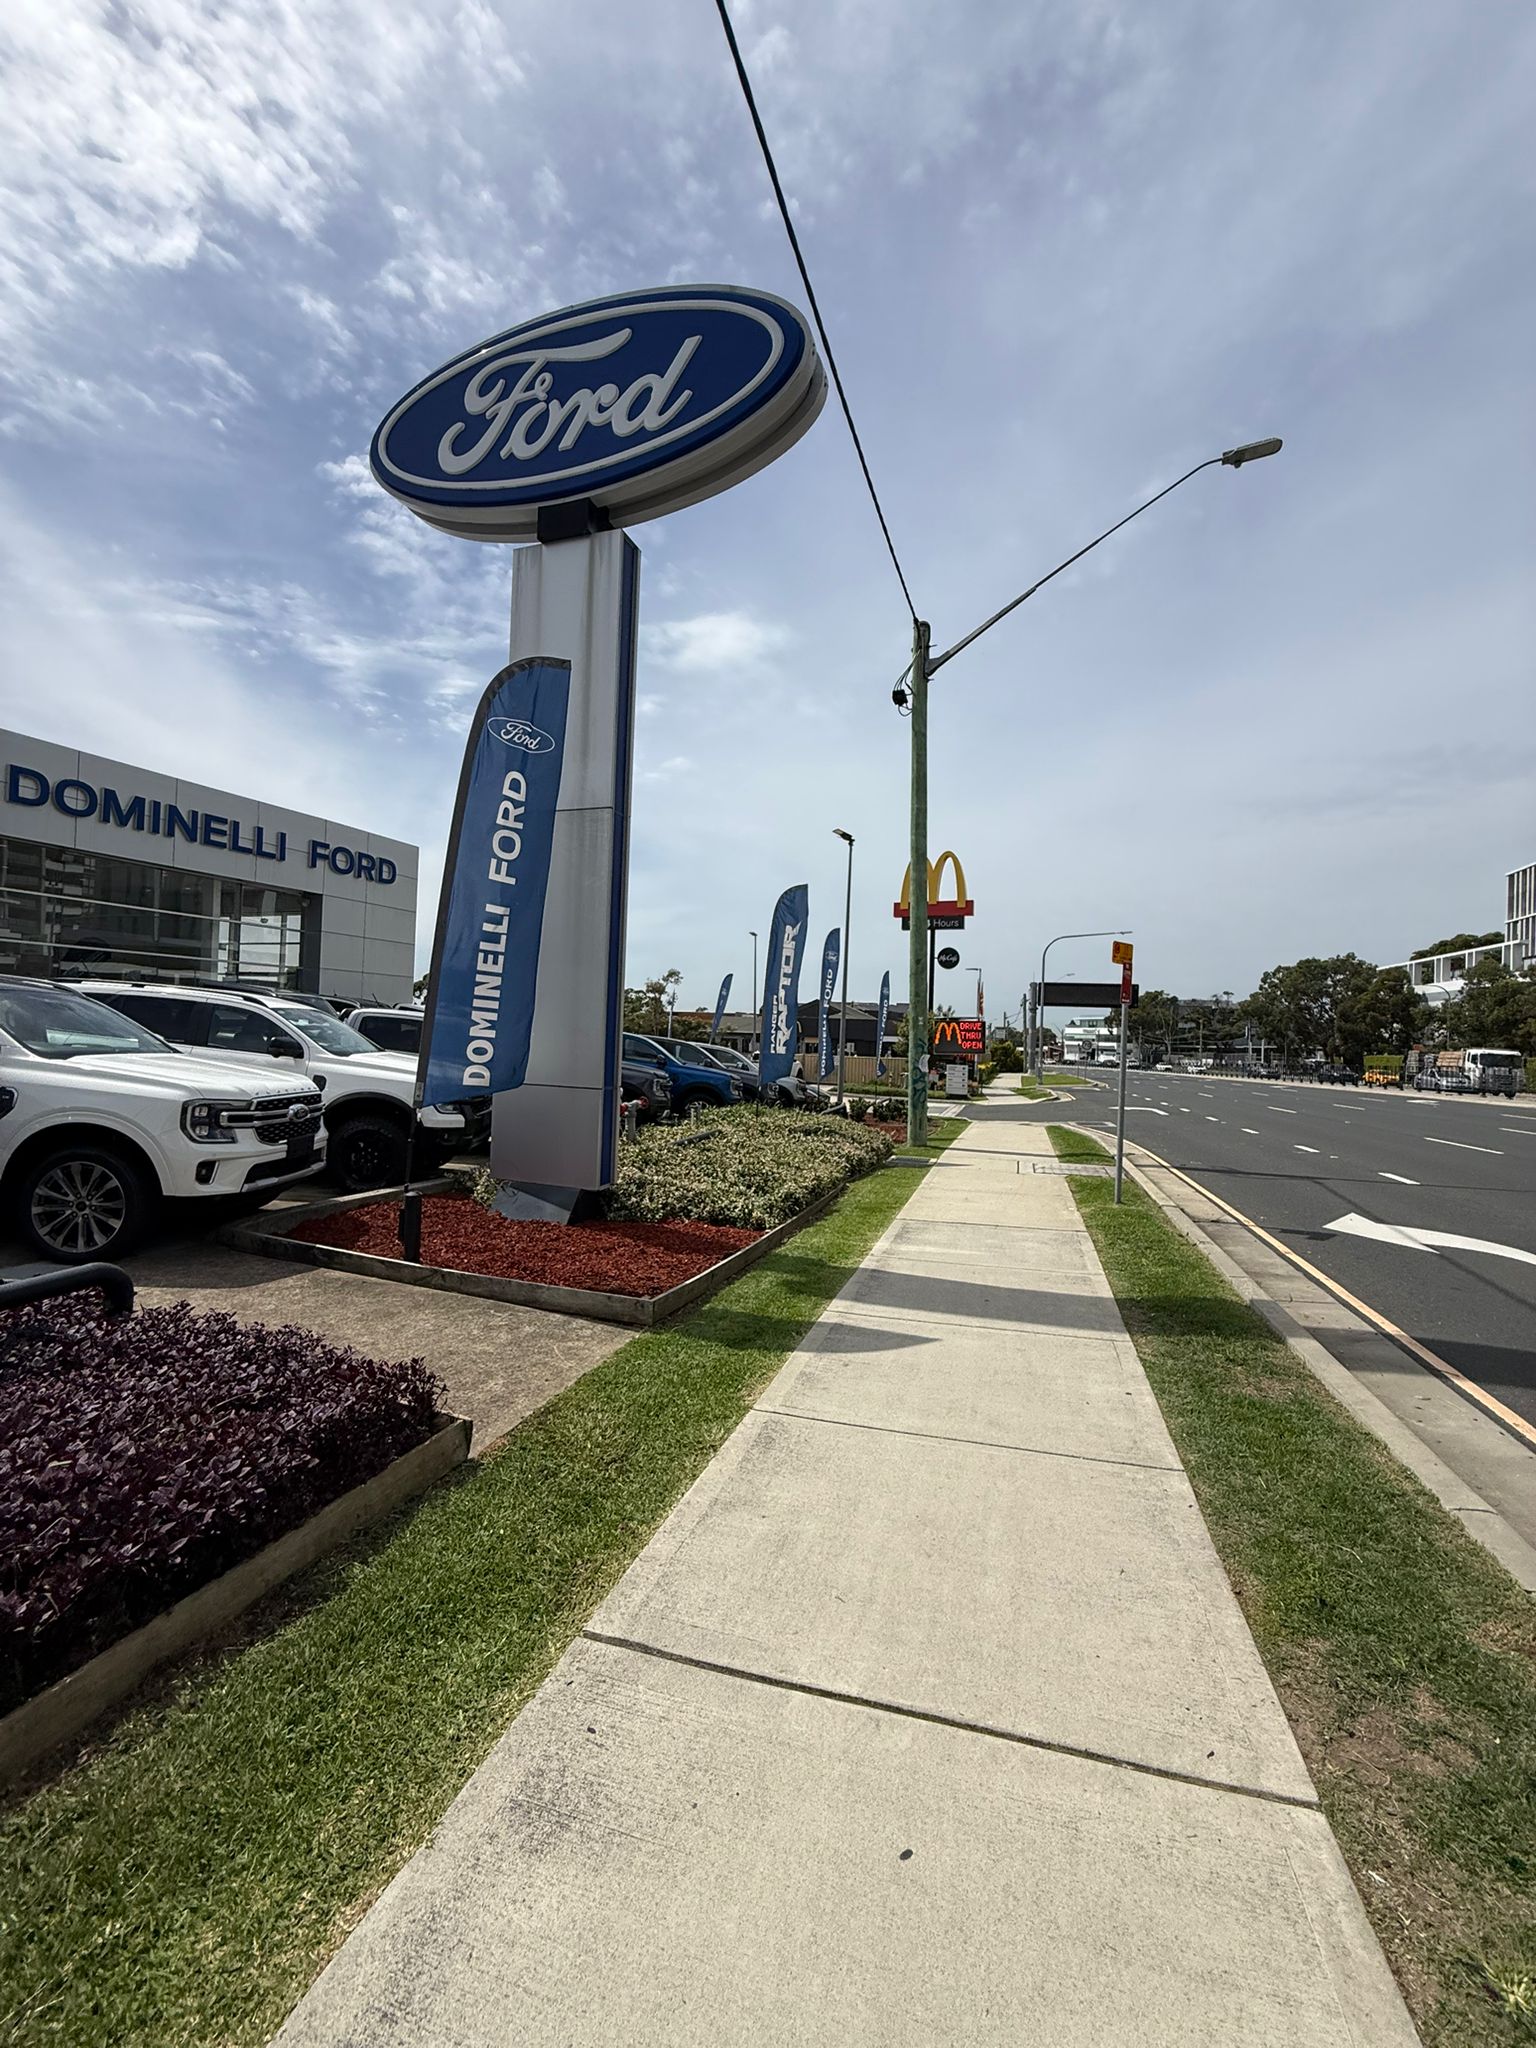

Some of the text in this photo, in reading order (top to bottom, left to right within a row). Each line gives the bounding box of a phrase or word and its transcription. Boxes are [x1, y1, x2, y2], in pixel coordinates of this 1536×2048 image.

[437, 328, 702, 474] Ford
[501, 722, 541, 749] Ford
[6, 764, 398, 885] DOMINELLI FORD
[462, 770, 528, 1088] DOMINELLI FORD
[933, 919, 960, 928] Hours
[775, 920, 802, 1055] RAPTOR
[823, 968, 834, 1008] FORD
[770, 994, 779, 1054] RANGER
[960, 1022, 982, 1030] DRIVE
[961, 1031, 982, 1040] THRU
[961, 1041, 983, 1049] OPEN
